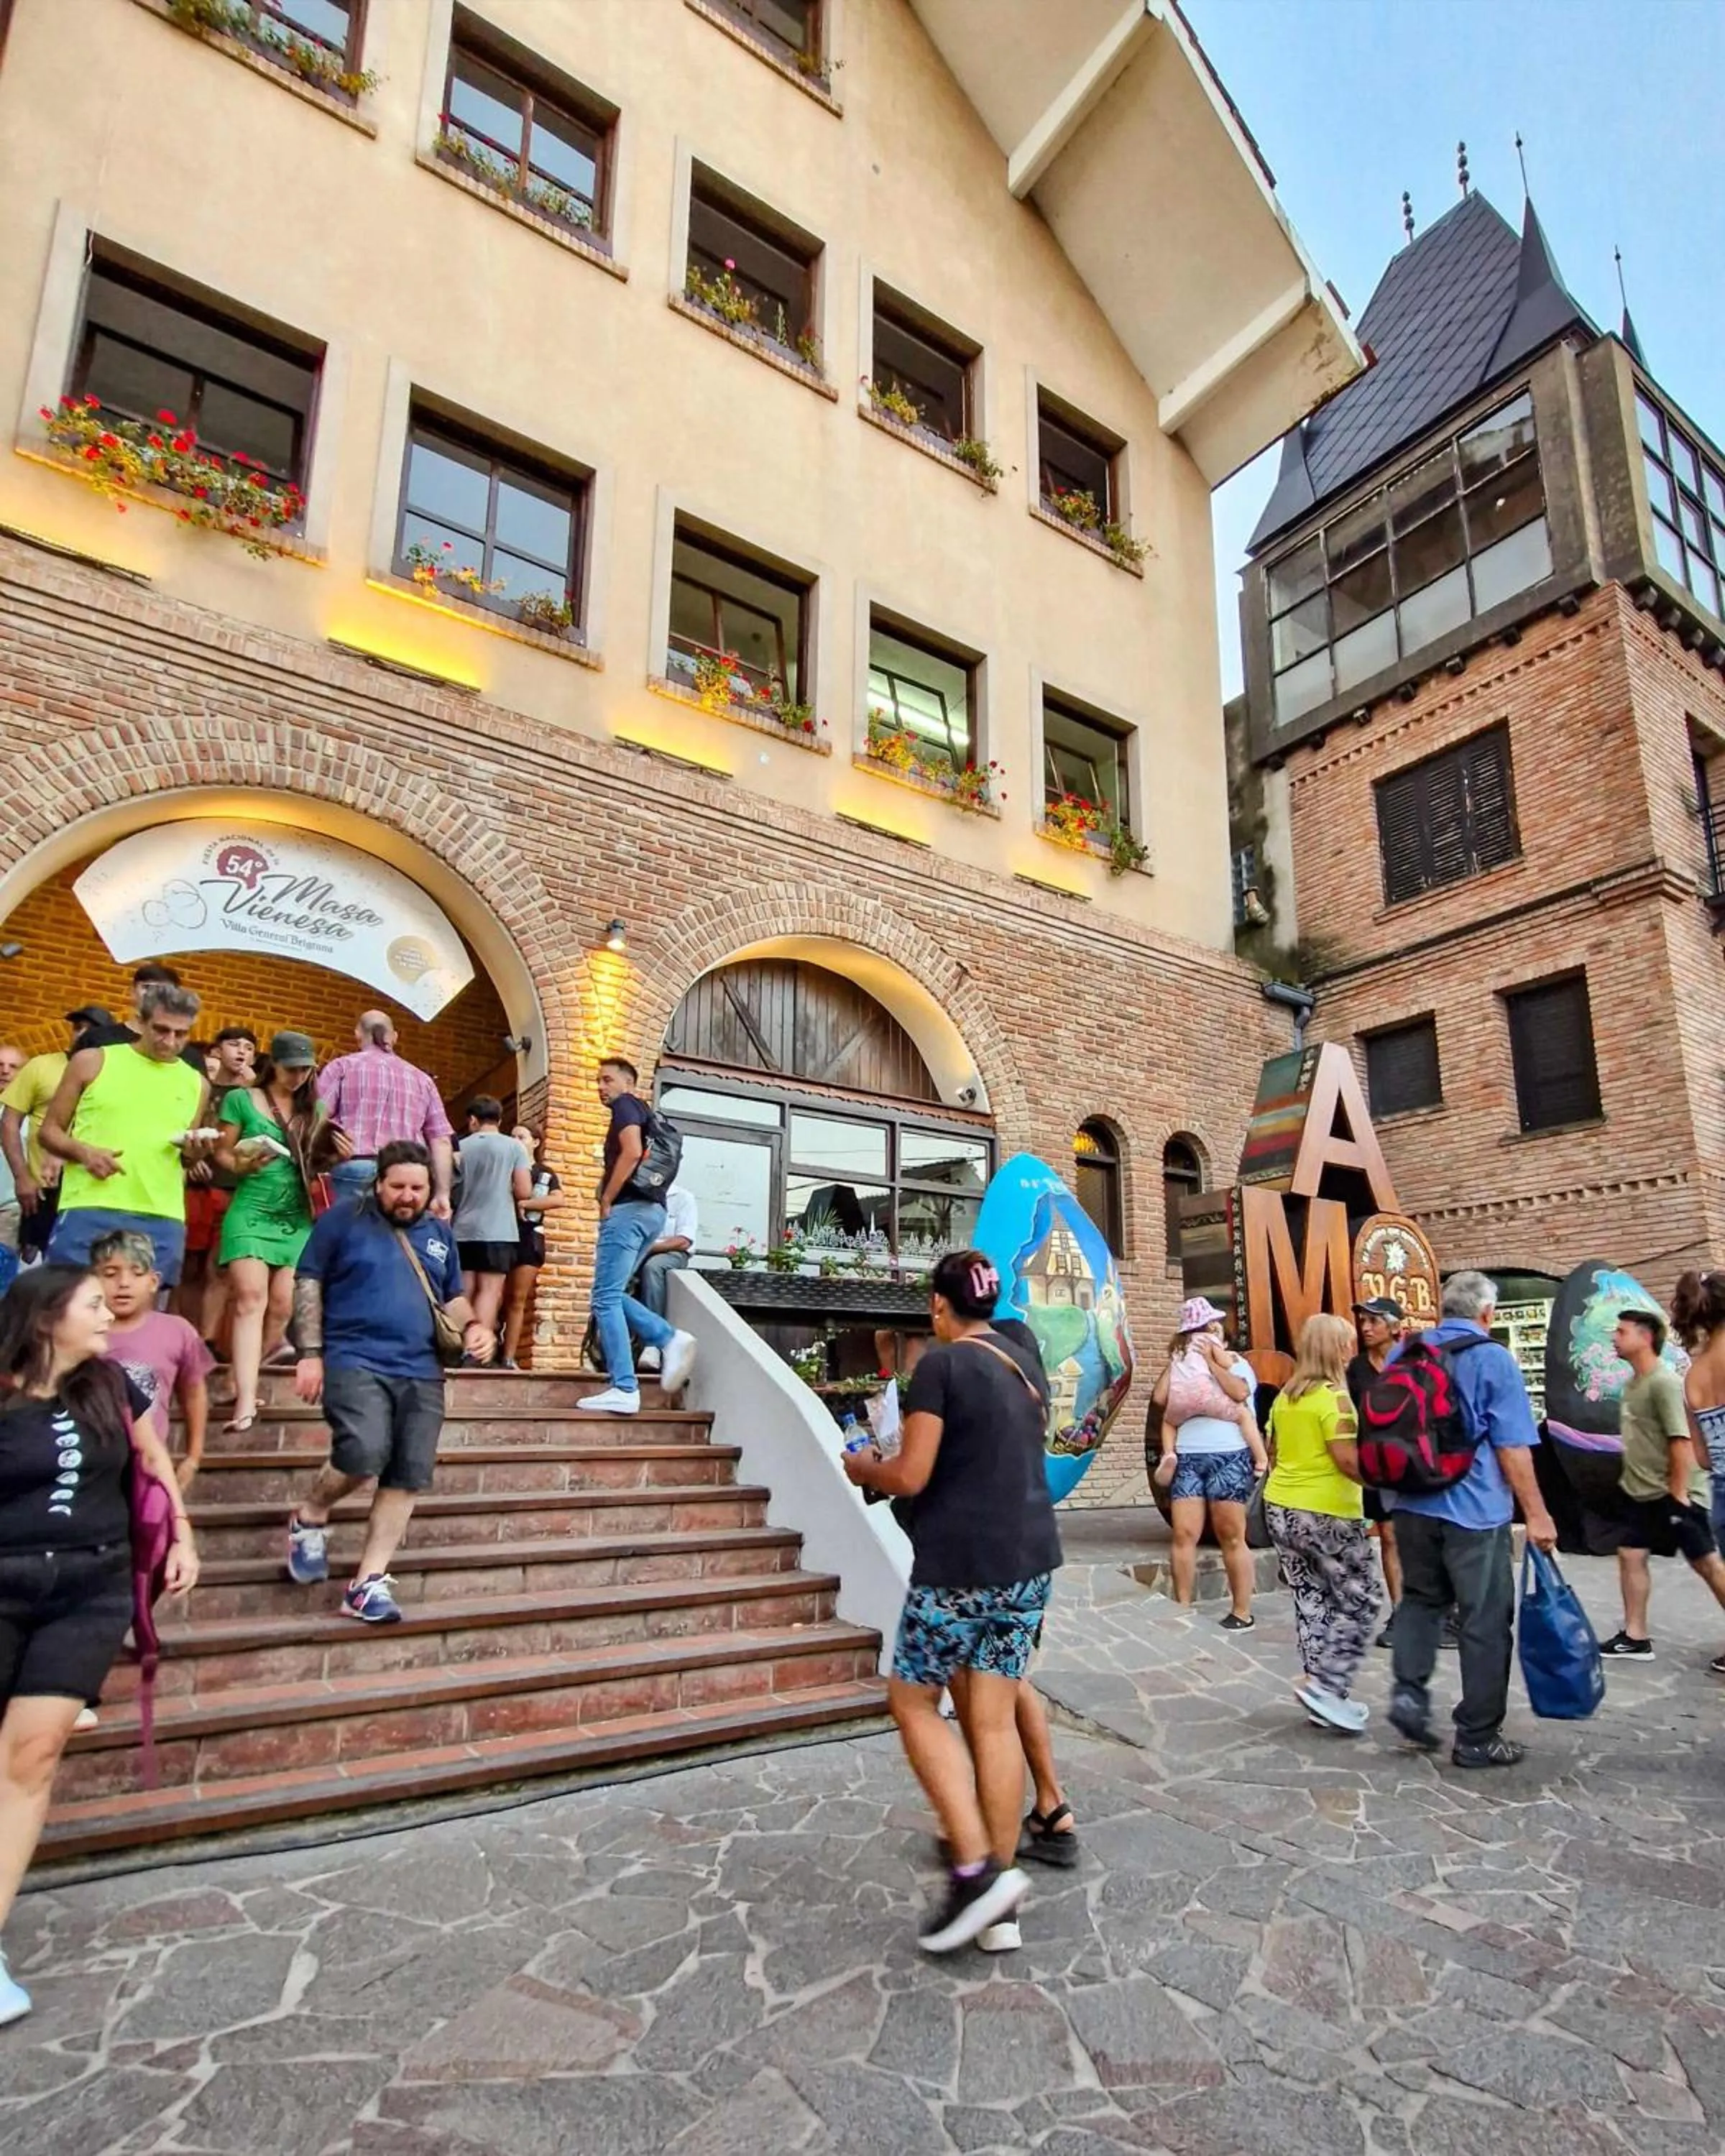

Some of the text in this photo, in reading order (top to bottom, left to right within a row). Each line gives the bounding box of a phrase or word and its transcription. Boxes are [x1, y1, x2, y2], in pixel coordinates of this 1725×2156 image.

[200, 879, 353, 939] Vienesa
[262, 874, 382, 925] Masa
[219, 918, 247, 933] Villa
